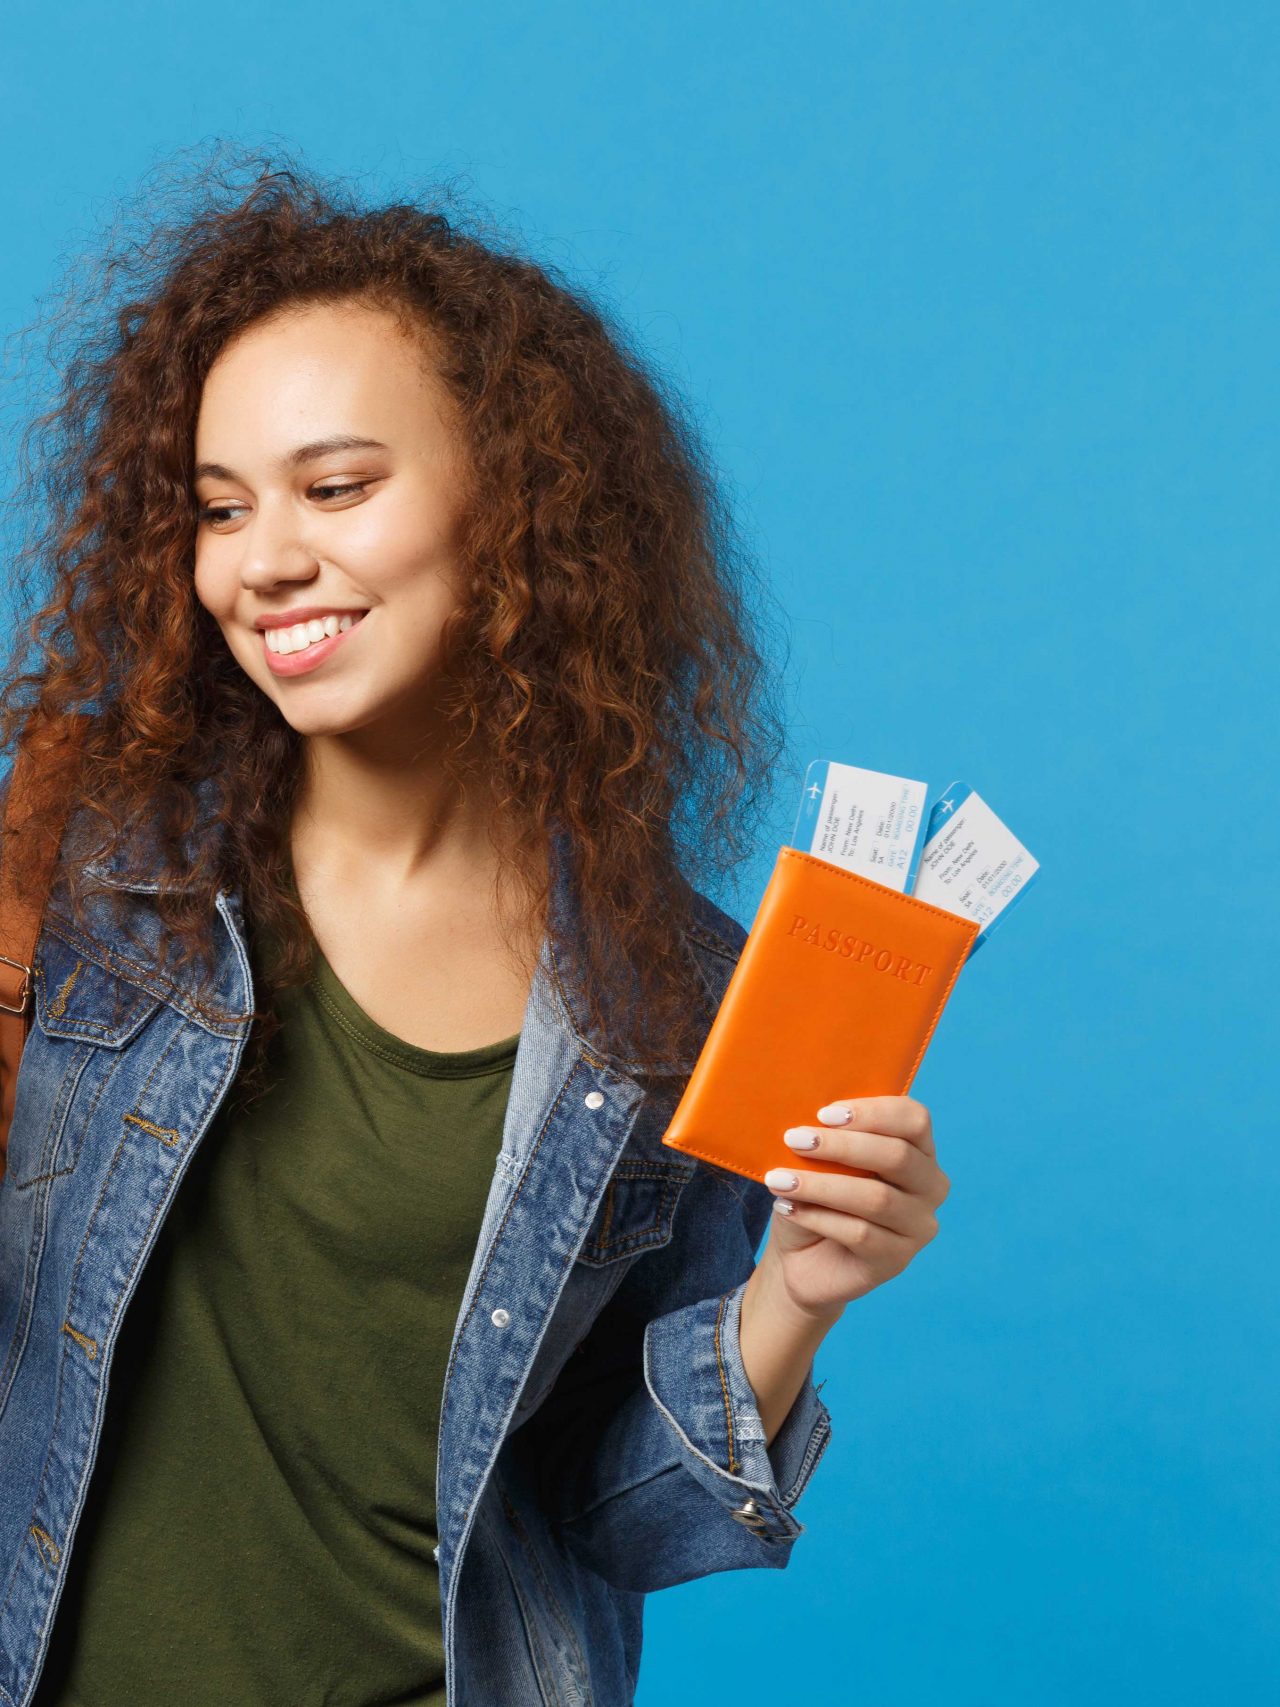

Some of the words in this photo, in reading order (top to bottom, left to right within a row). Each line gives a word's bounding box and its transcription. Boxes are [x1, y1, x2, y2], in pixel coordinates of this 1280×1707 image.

[854, 809, 865, 833] Angeles
[820, 833, 828, 850] Name
[827, 833, 836, 852] JOHN
[832, 816, 840, 831] DOE
[841, 838, 849, 855] From:
[888, 850, 896, 866] GATE
[897, 849, 907, 868] A12
[787, 914, 933, 986] PASSPORT
